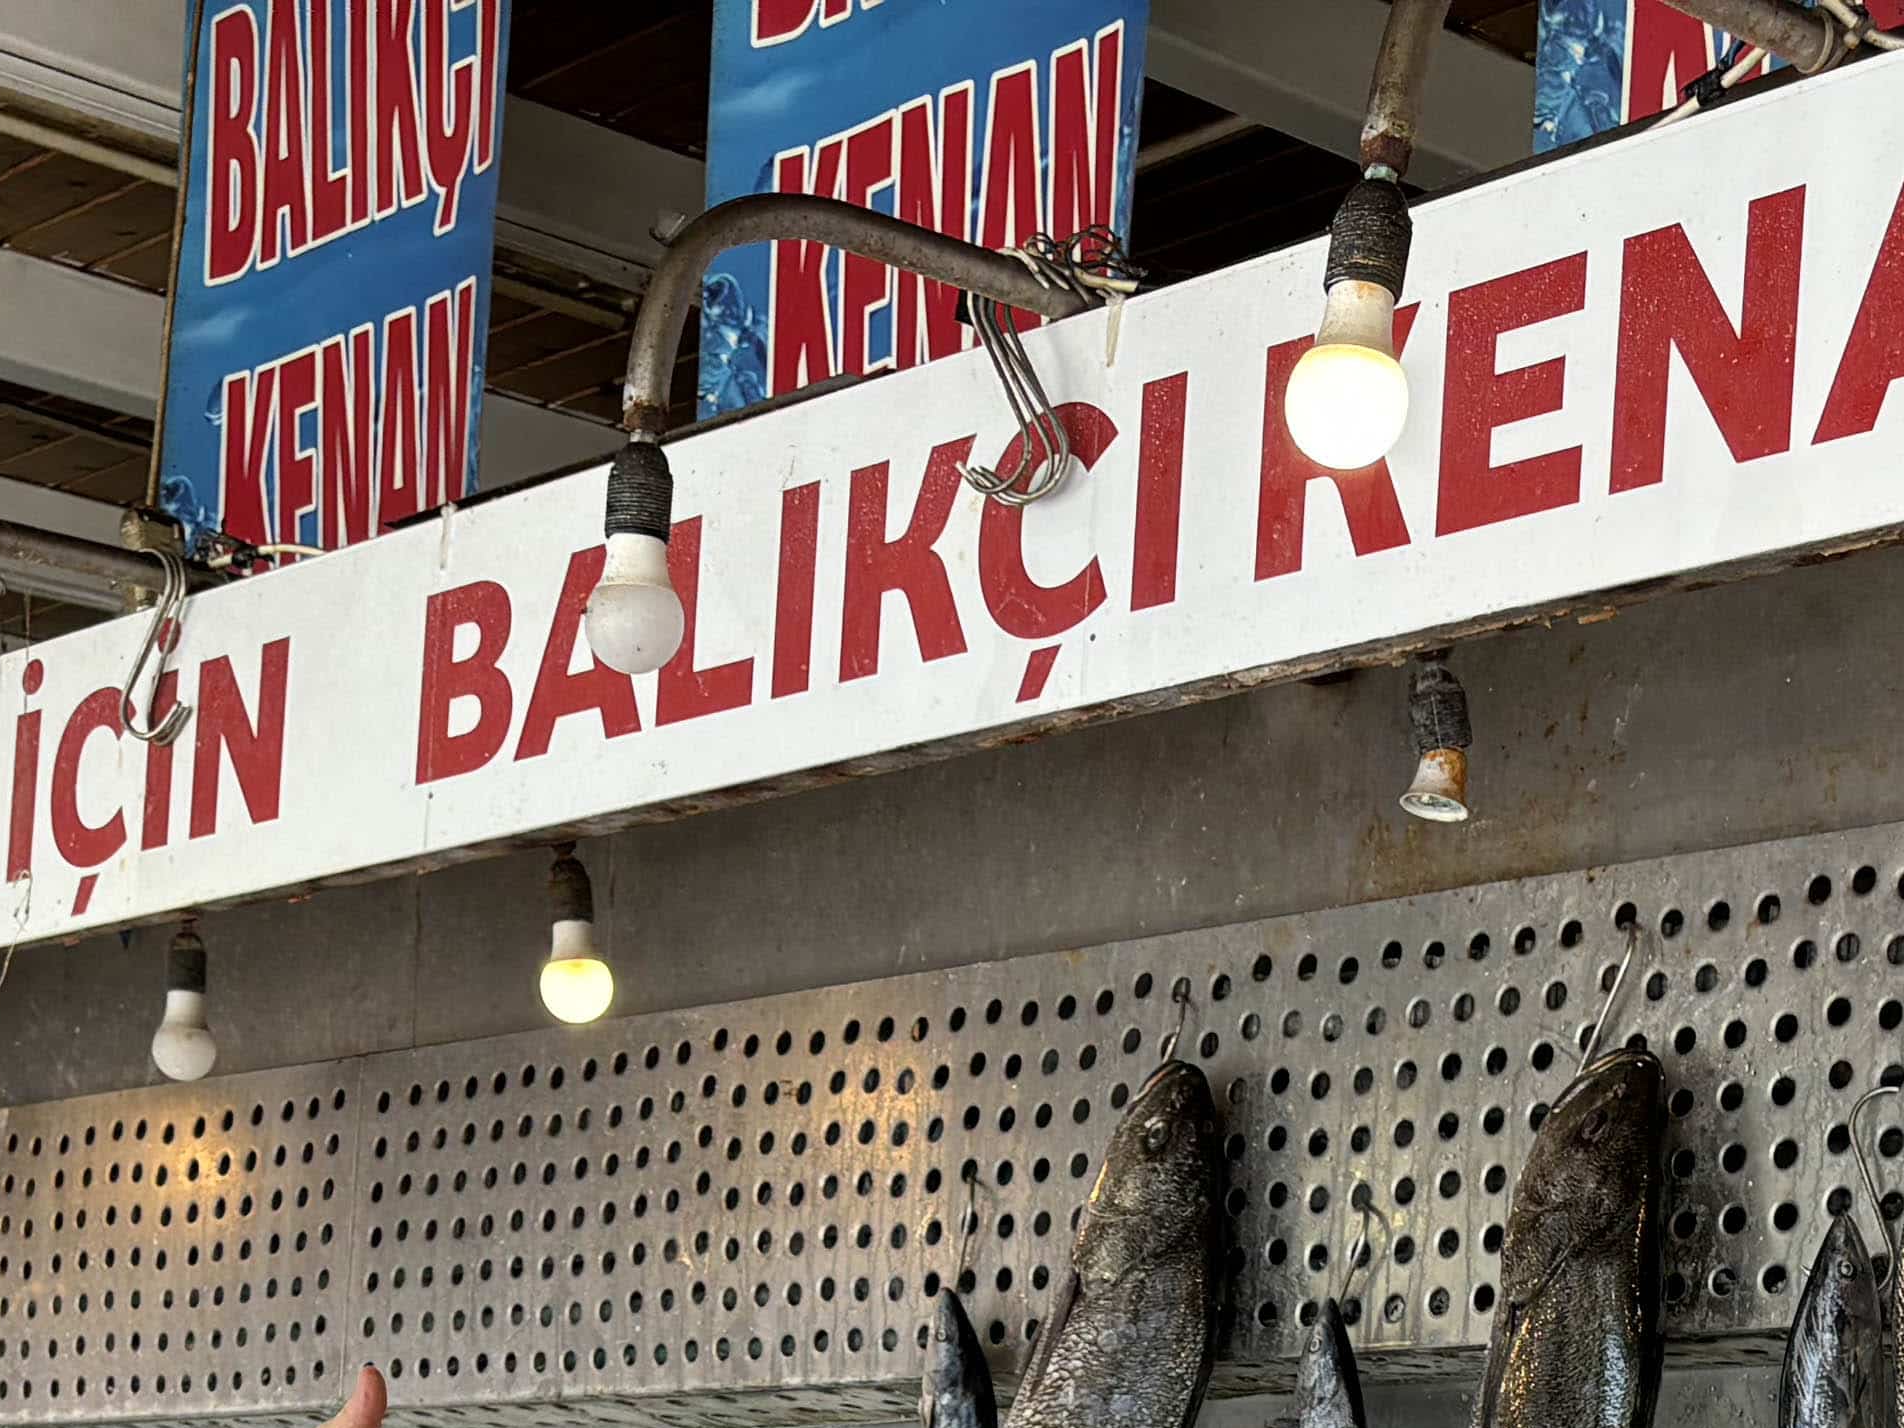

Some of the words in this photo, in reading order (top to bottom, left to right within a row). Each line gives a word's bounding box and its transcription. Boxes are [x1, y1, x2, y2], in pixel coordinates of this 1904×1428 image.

[767, 19, 1124, 400] KENAN
[218, 276, 476, 575] KENAN
[415, 370, 1188, 785] BALIKÇI
[6, 618, 291, 917] İÇİN
